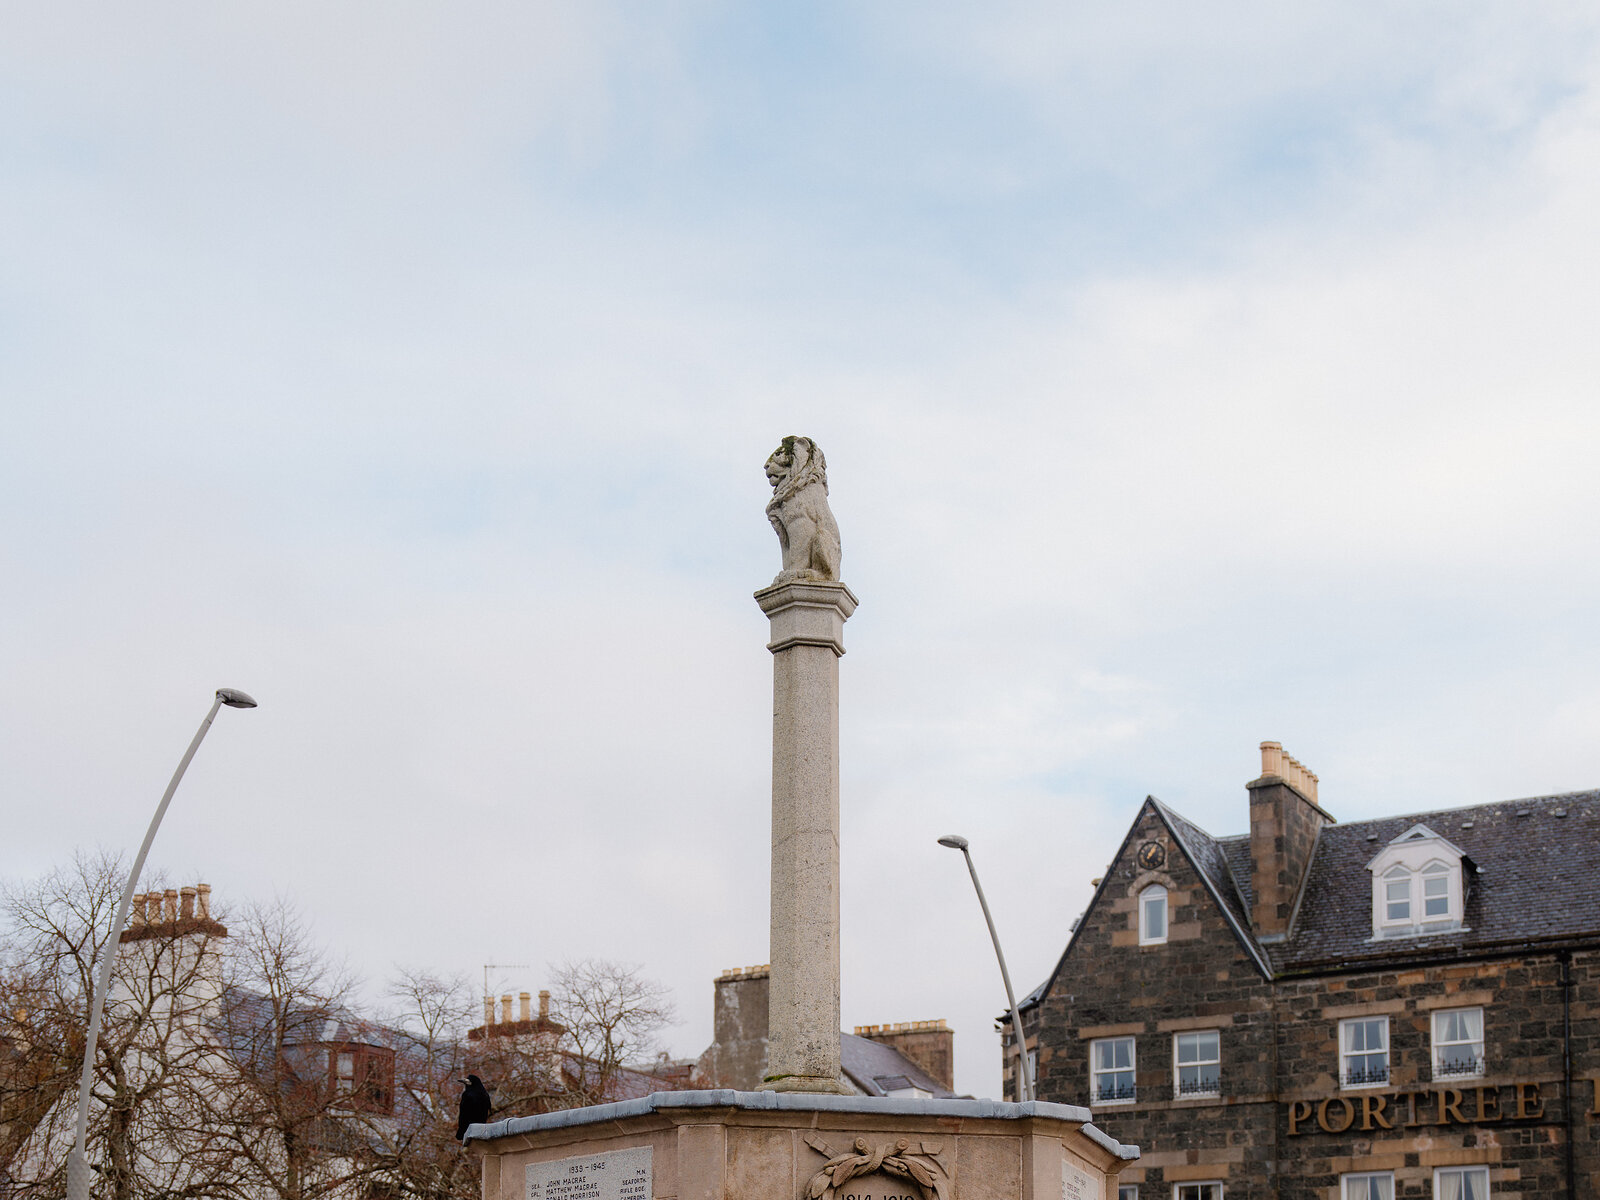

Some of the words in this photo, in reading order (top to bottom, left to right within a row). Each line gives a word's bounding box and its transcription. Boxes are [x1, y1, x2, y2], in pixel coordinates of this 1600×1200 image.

[1286, 1081, 1544, 1136] PORTREE
[547, 1180, 560, 1188] JOHN
[563, 1176, 586, 1185] MACRAE
[546, 1187, 573, 1195] MATTHEW
[574, 1183, 598, 1191] MACRAE
[570, 1190, 600, 1200] MORRISON
